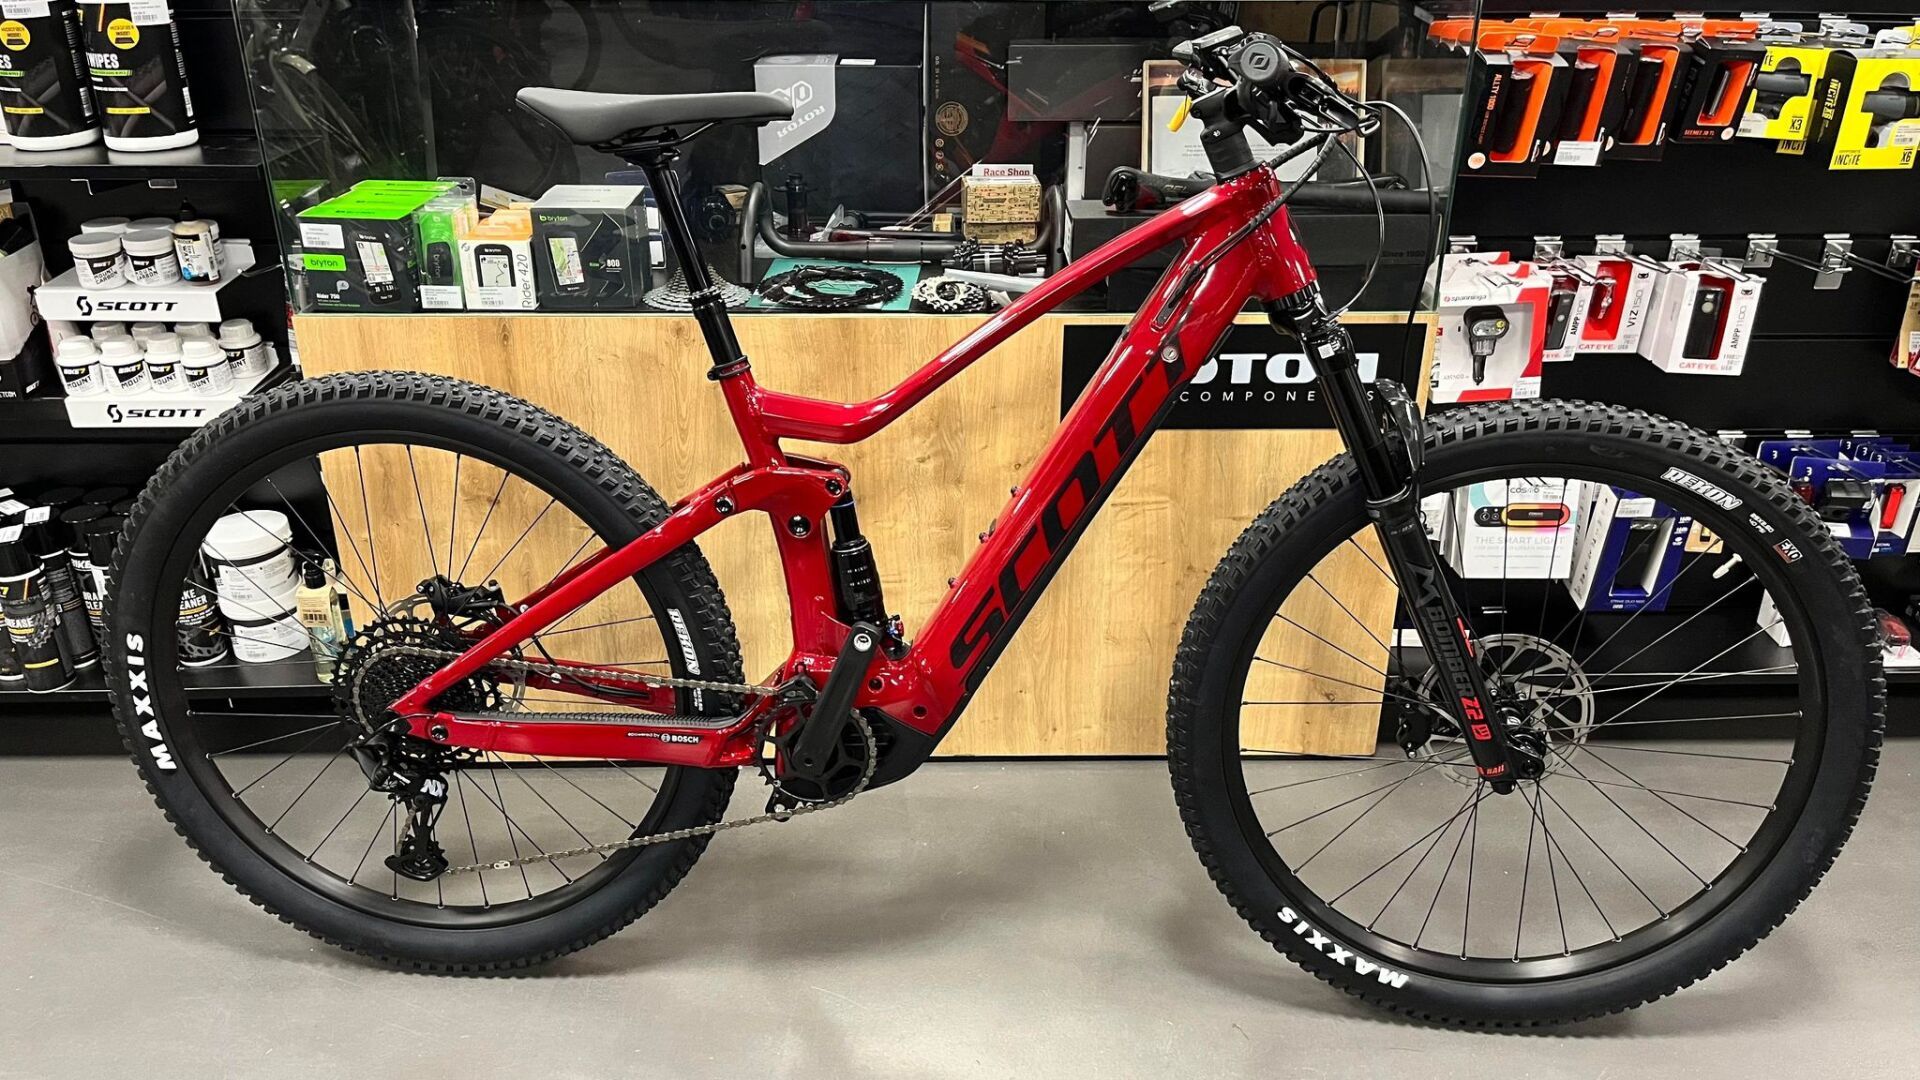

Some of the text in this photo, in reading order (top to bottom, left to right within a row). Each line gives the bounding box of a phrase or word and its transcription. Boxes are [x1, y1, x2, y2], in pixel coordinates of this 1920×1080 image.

[1491, 74, 1502, 94] ALLTY
[1789, 119, 1803, 131] X3
[1901, 151, 1912, 162] X6
[983, 167, 1030, 176] Race Shop
[310, 258, 338, 267] bryton
[606, 258, 621, 268] 800
[516, 254, 533, 309] Rider 420
[96, 301, 178, 311] SCOTT
[1570, 316, 1580, 335] AMPP
[1626, 309, 1639, 328] VIZ
[1730, 328, 1741, 349] AMPP
[1679, 362, 1716, 370] CATEYE
[121, 371, 147, 390] MOUNT
[1180, 390, 1374, 402] COMPONES
[126, 409, 206, 417] SCOTT
[949, 303, 1194, 669] SCOTT
[1660, 466, 1743, 511] REKON
[1779, 539, 1803, 560] EXO
[82, 591, 100, 601] BRA
[666, 608, 700, 676] REKON
[1426, 605, 1475, 699] BOMBER
[126, 632, 178, 770] MAXXIS
[1461, 697, 1484, 720] Z2
[671, 735, 699, 743] BOSCH
[1277, 906, 1410, 989] MAXXIS
